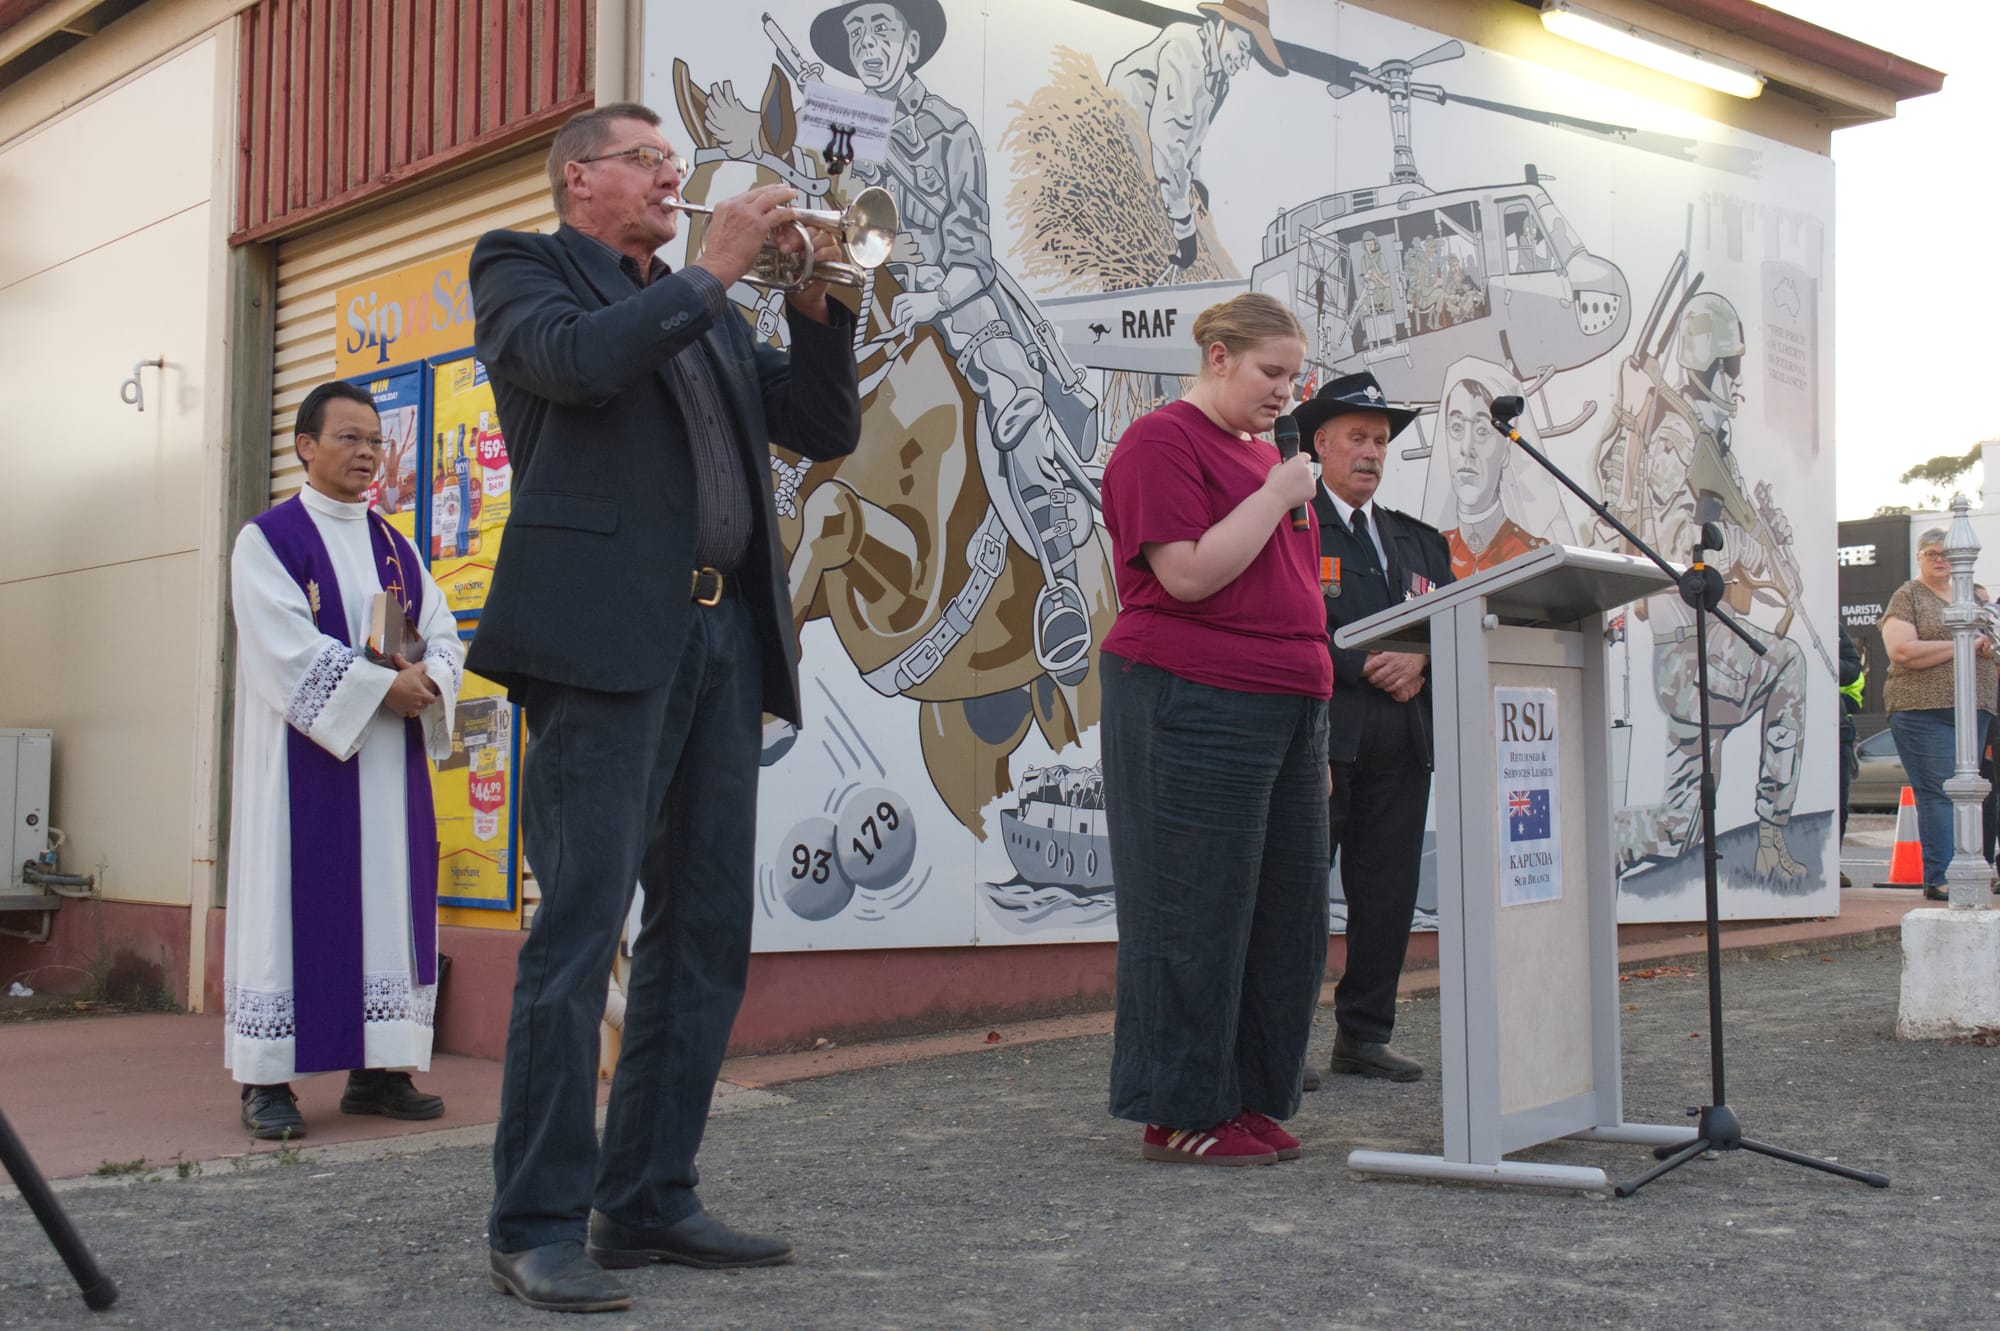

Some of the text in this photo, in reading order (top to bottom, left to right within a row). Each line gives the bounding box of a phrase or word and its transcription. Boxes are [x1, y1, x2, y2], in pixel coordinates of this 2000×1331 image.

[1122, 308, 1177, 339] RAAF
[370, 378, 389, 394] WIN
[1841, 604, 1883, 616] BARISTA
[1847, 615, 1878, 626] MADE
[1501, 702, 1553, 742] RSL
[853, 802, 899, 865] 179
[791, 844, 832, 884] 93
[1510, 851, 1553, 870] KAPUNDA
